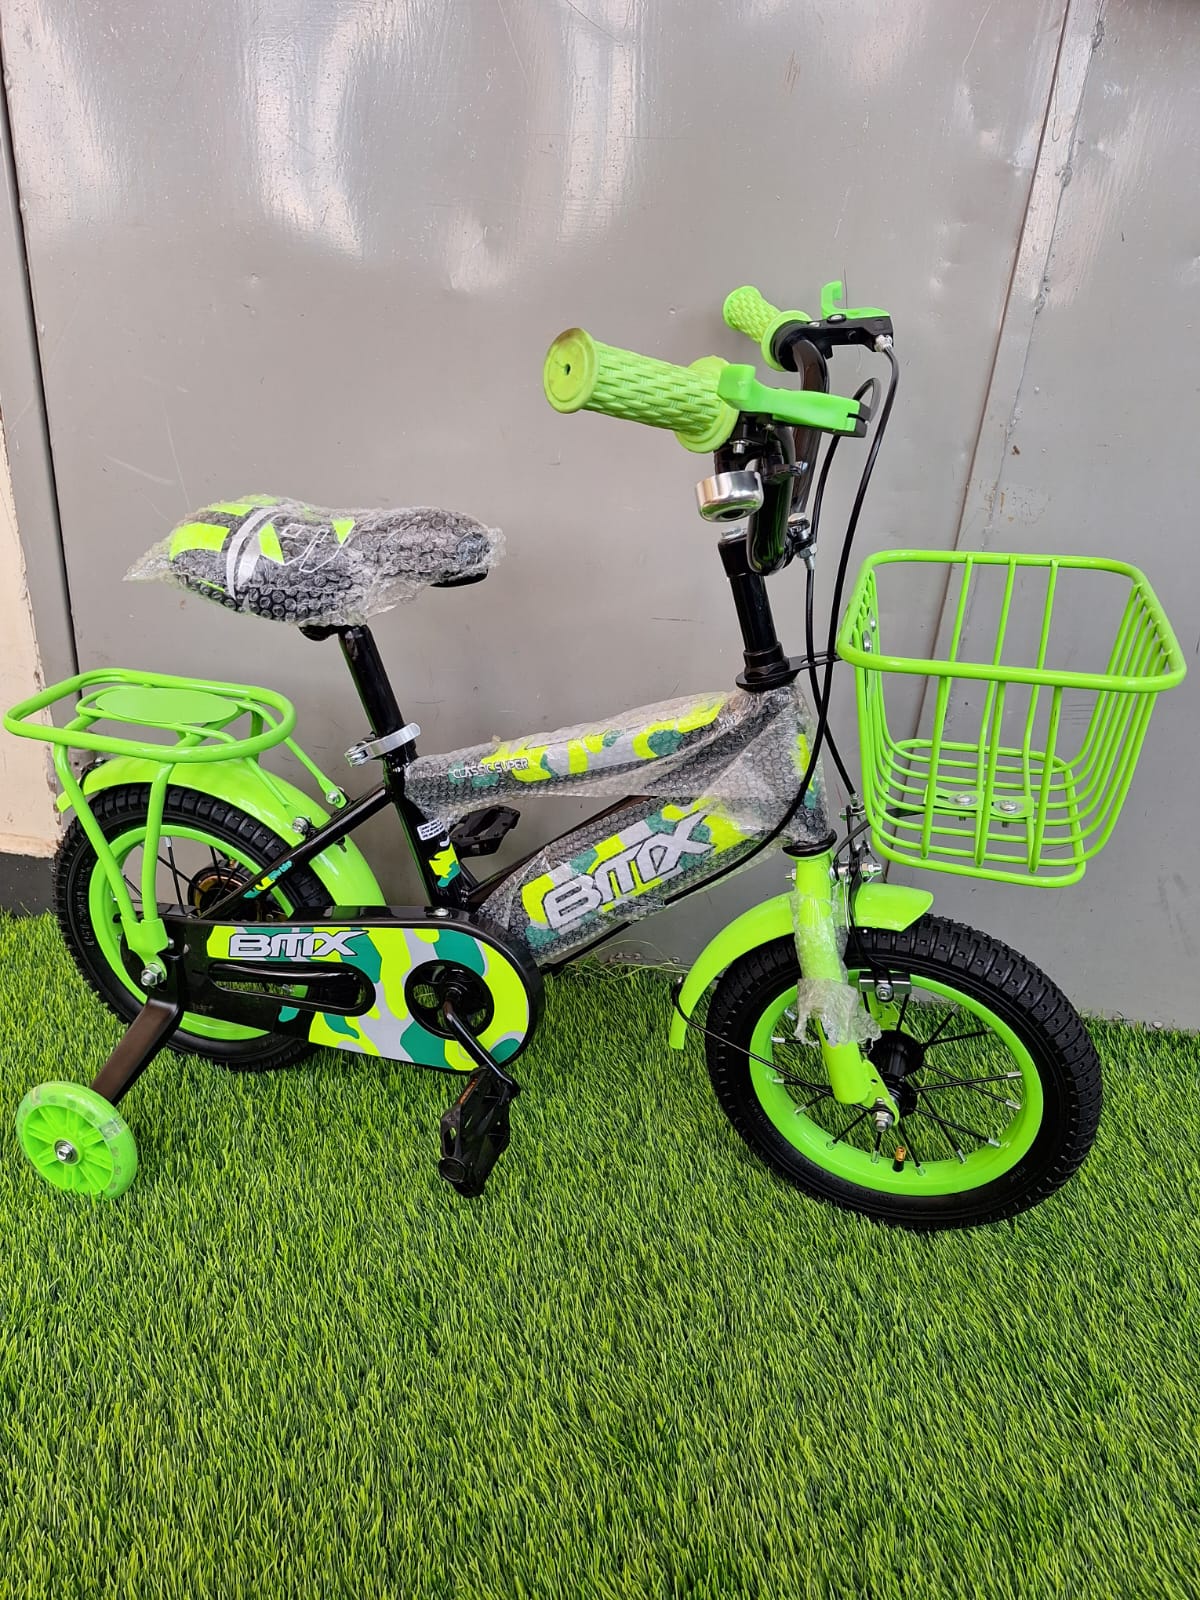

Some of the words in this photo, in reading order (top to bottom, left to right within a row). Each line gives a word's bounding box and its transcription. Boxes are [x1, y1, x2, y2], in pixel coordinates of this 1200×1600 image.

[453, 763, 494, 779] CLASSIC
[494, 758, 529, 773] SUPER
[543, 812, 716, 931] BMX
[229, 929, 369, 959] BMX
